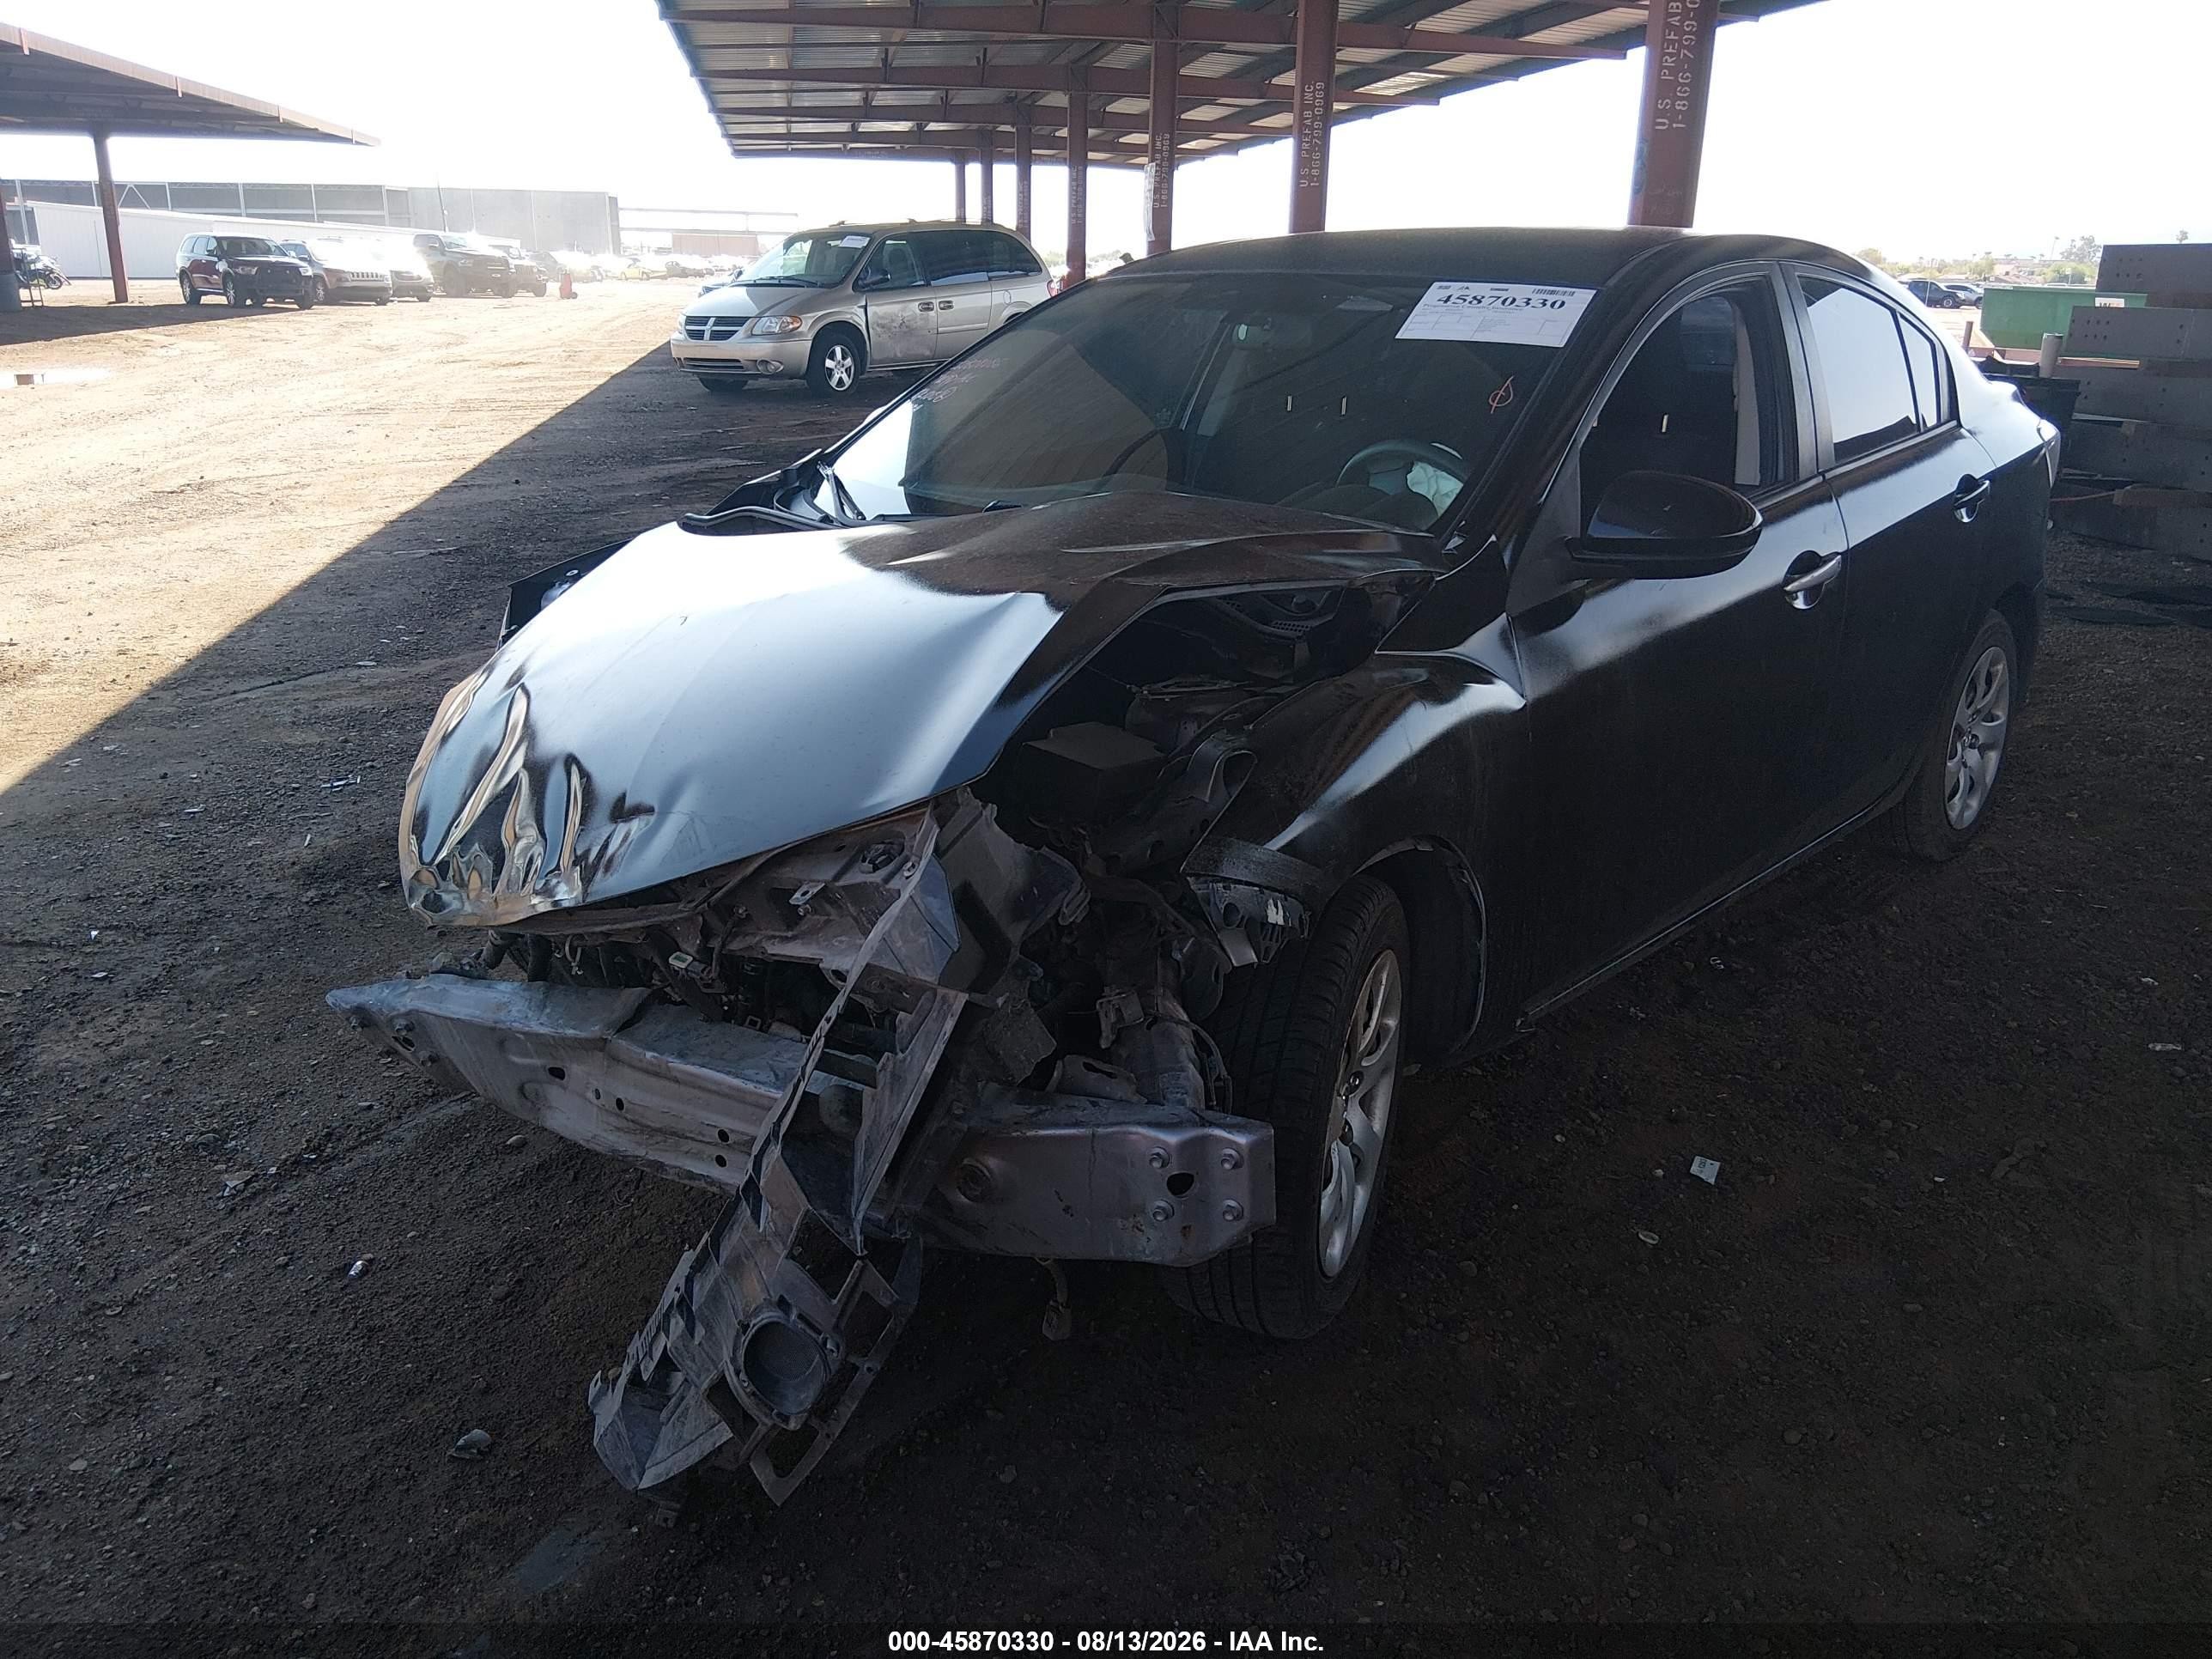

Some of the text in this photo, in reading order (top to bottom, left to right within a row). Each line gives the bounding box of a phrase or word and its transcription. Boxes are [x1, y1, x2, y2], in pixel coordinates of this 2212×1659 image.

[1661, 2, 1681, 80] PREFAB
[1304, 81, 1315, 104] INC.
[1302, 111, 1313, 157] PREFAB
[1310, 82, 1325, 186] 1-866-799-0969
[1437, 294, 1566, 310] 45870330
